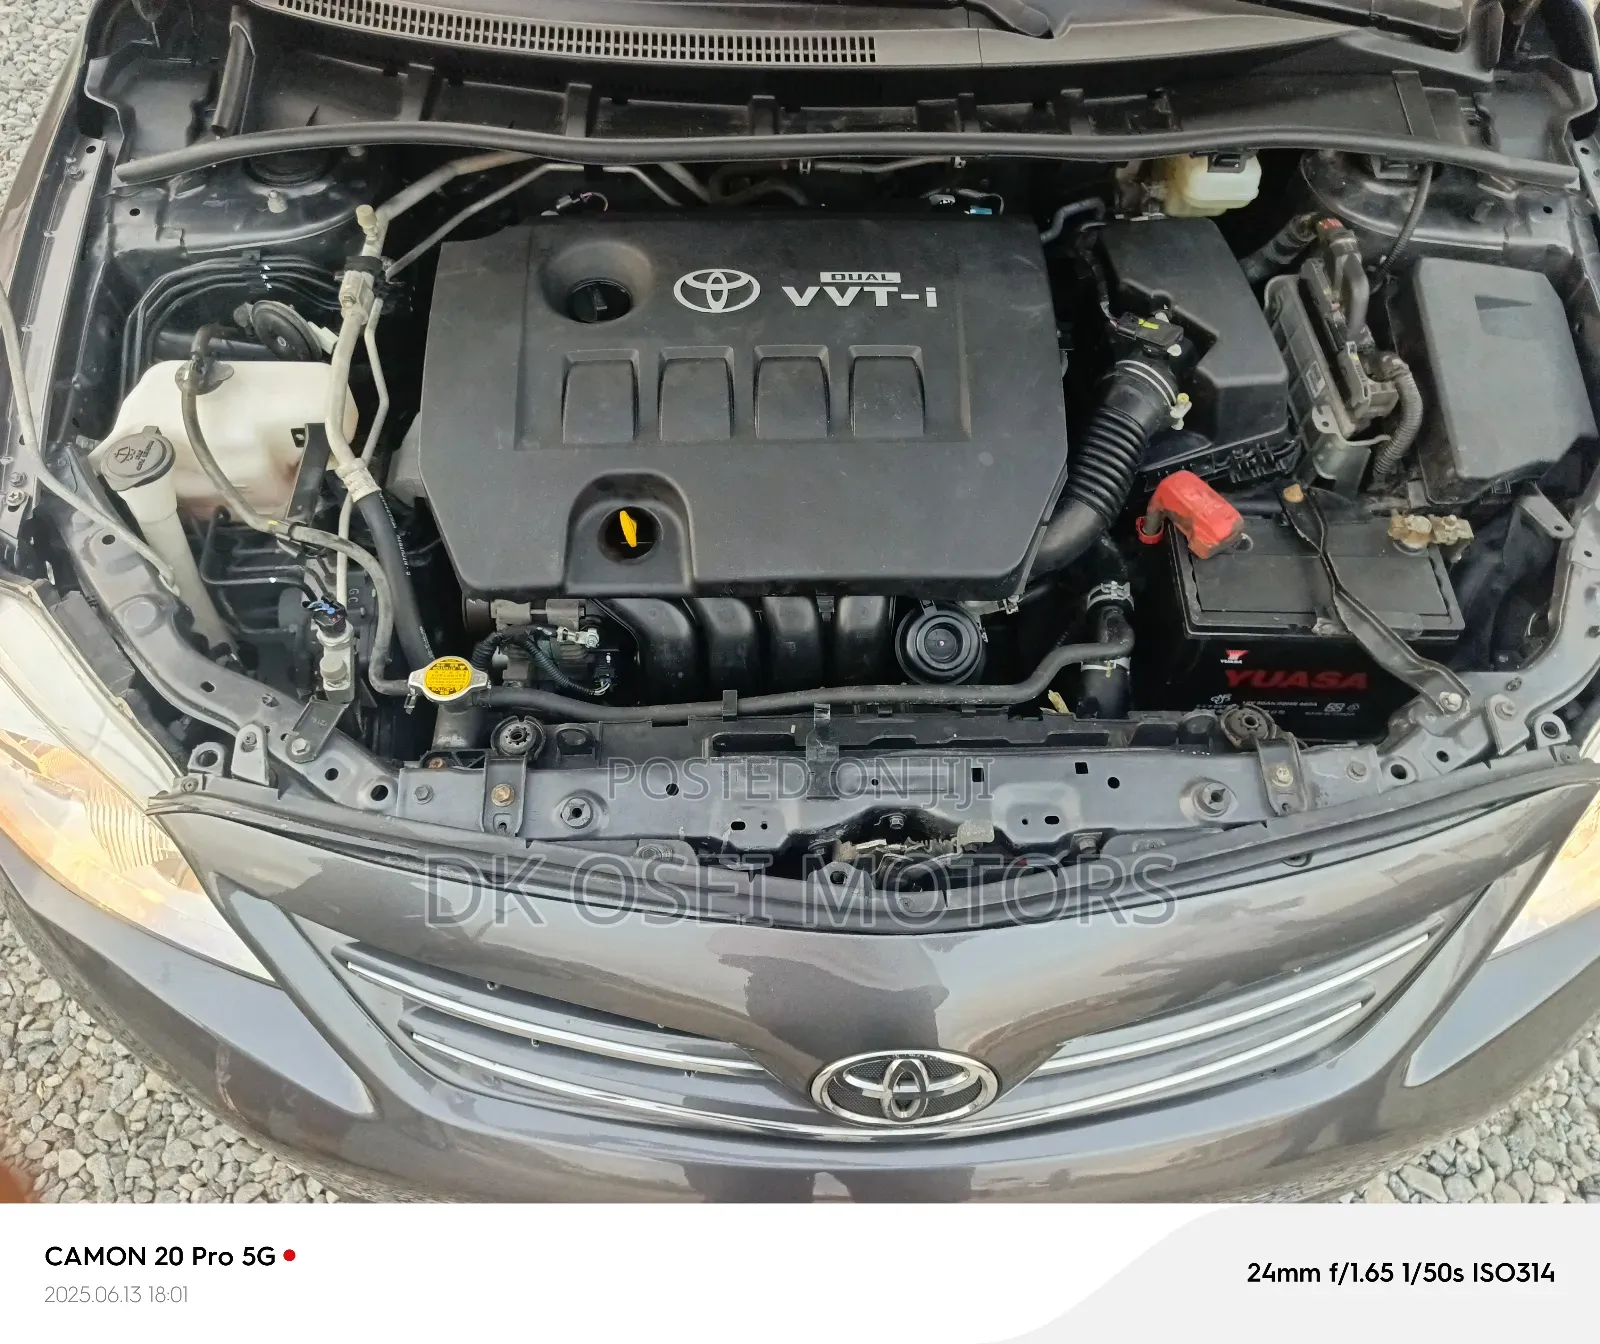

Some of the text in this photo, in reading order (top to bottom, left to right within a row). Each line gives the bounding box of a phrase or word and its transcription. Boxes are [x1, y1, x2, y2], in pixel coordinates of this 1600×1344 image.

[831, 273, 893, 281] DUAL
[781, 286, 938, 308] VVT-i
[1224, 670, 1368, 689] YUASA
